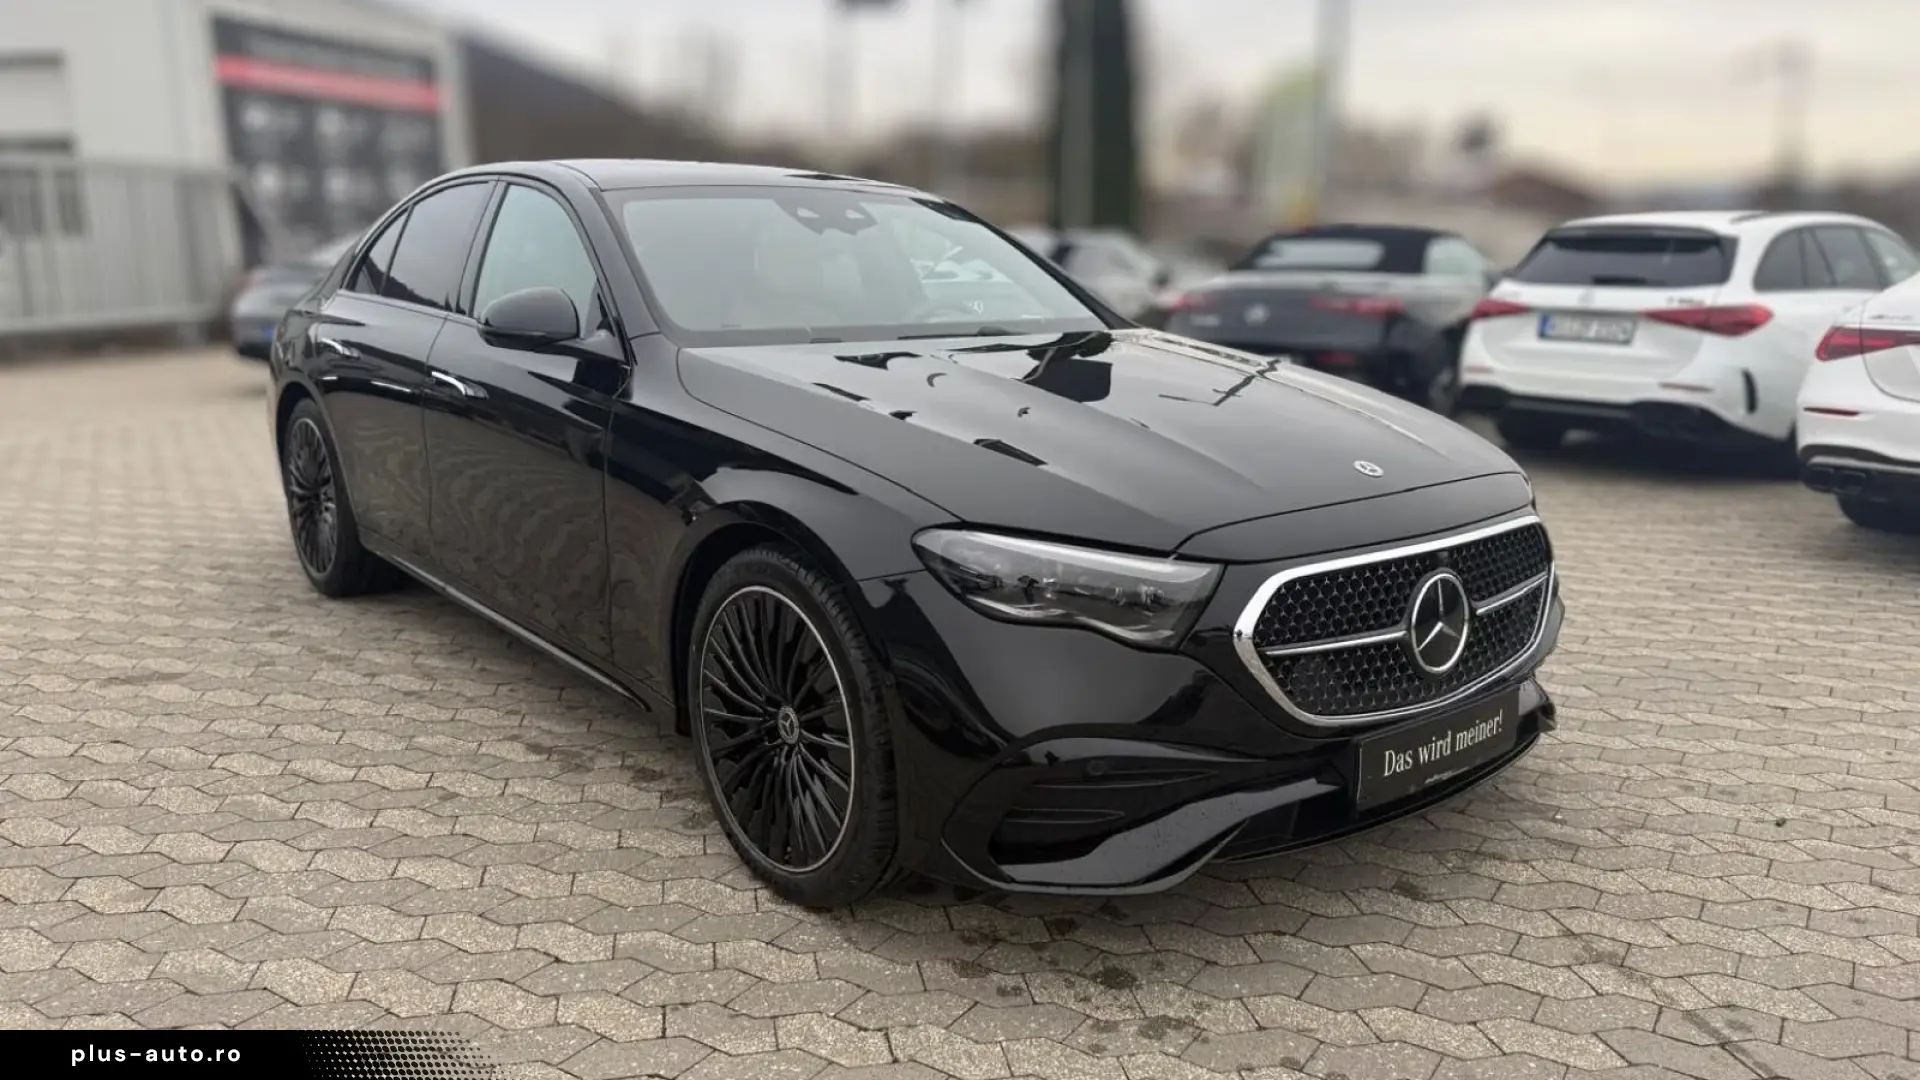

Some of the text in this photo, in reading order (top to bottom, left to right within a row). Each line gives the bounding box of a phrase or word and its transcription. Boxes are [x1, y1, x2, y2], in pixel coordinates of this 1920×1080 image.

[1383, 749, 1413, 777] Das
[1418, 729, 1452, 765] wird
[1455, 708, 1503, 752] meiner!
